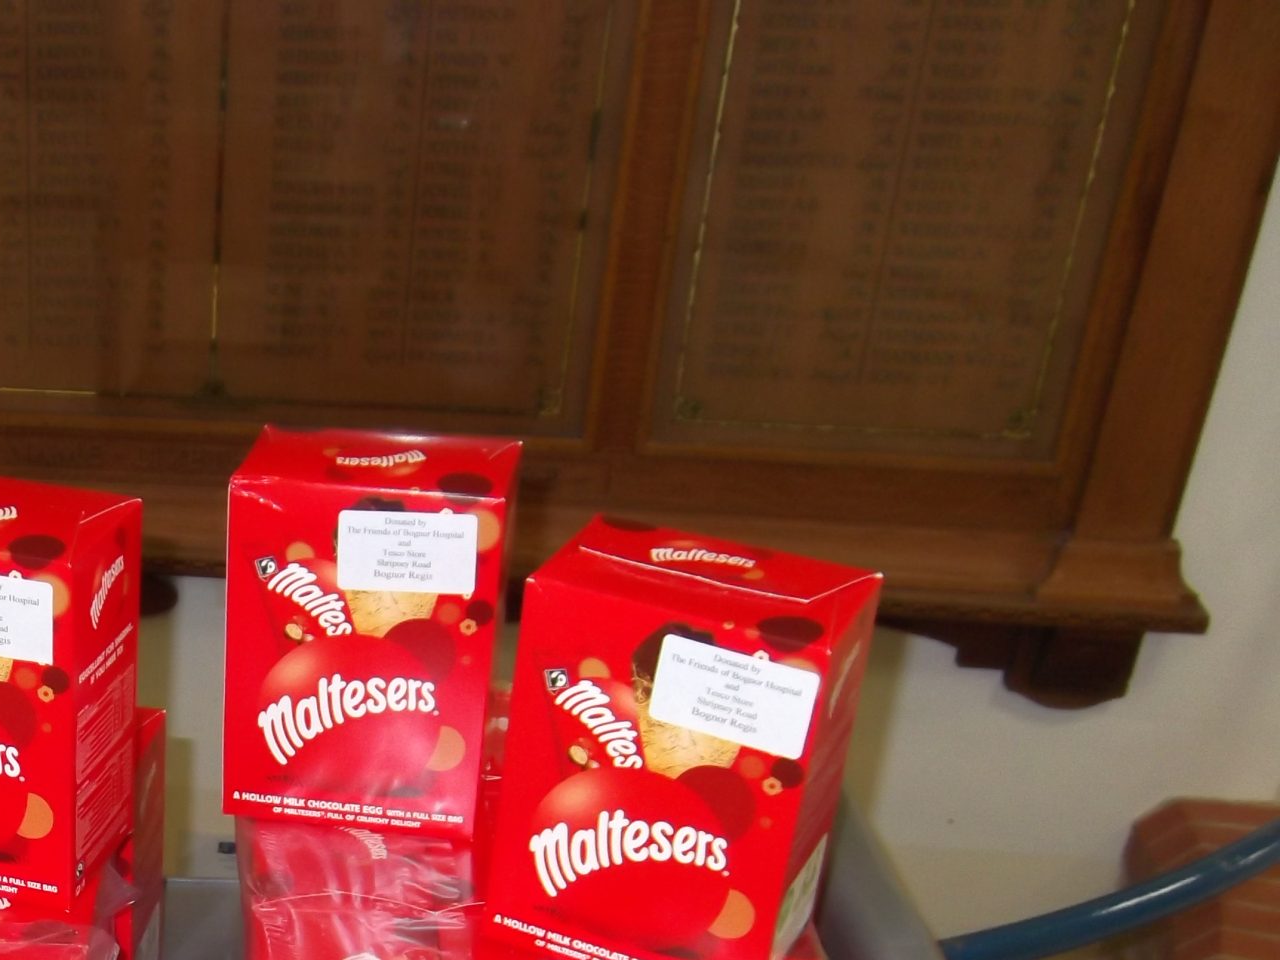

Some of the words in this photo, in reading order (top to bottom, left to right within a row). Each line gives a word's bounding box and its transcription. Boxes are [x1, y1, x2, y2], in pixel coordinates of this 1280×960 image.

[336, 450, 427, 467] Maltesers
[650, 547, 756, 567] Maltesers
[9, 594, 40, 606] Hospital
[90, 555, 124, 630] Maltesers
[268, 562, 352, 636] Maltes
[257, 673, 437, 765] Maltesers
[555, 680, 643, 769] Maltes
[233, 791, 240, 800] A
[242, 792, 282, 804] HOLLOW
[283, 796, 305, 807] MILK
[308, 800, 360, 812] CHOCOLATE
[362, 806, 382, 815] EGG
[386, 809, 404, 818] WITH
[412, 812, 430, 820] FULL
[391, 818, 421, 828] DELIGHT
[529, 809, 727, 897] Maltesers
[10, 878, 25, 886] FULL
[494, 914, 502, 924] A
[504, 918, 545, 937] HOLLOW
[547, 930, 571, 945] MILK
